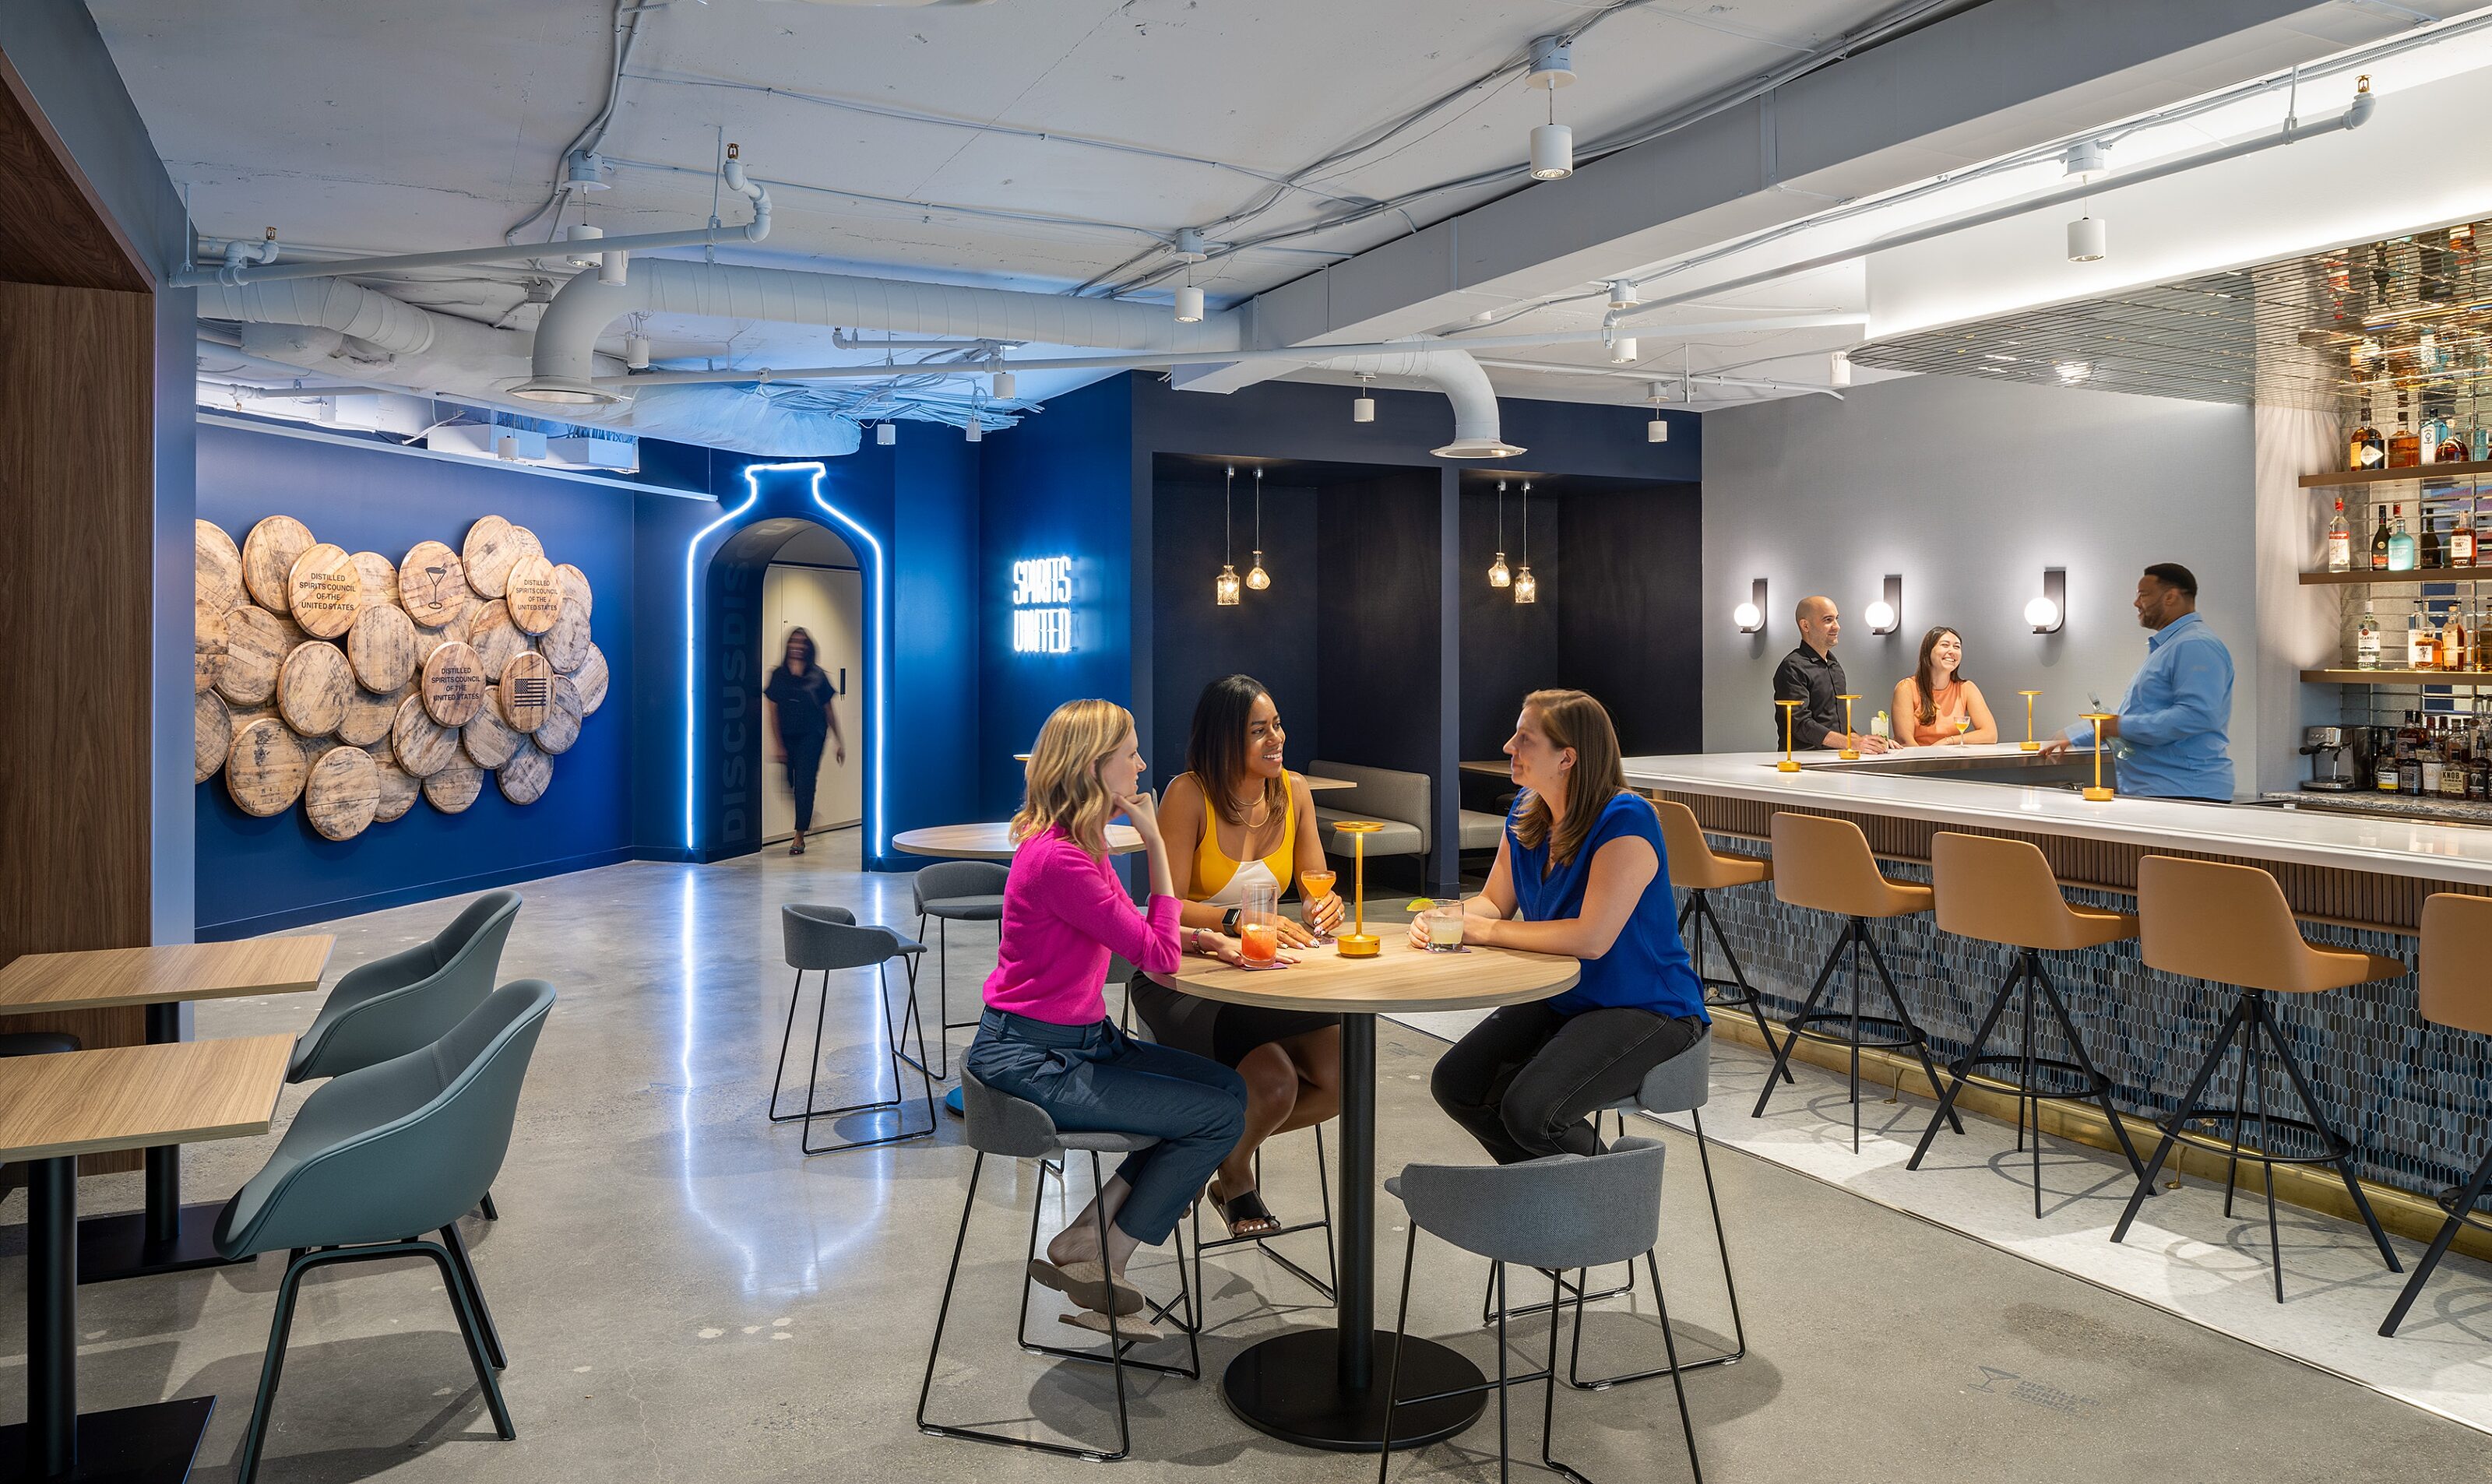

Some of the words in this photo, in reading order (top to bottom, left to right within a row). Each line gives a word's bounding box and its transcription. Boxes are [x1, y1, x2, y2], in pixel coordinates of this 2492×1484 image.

[311, 572, 346, 582] DISTILLED
[1013, 556, 1072, 604] SPIRITS
[299, 582, 326, 590] SPIRITS
[328, 603, 354, 611] STATES
[1013, 608, 1072, 653] UNITED
[2442, 771, 2460, 779] KNOB
